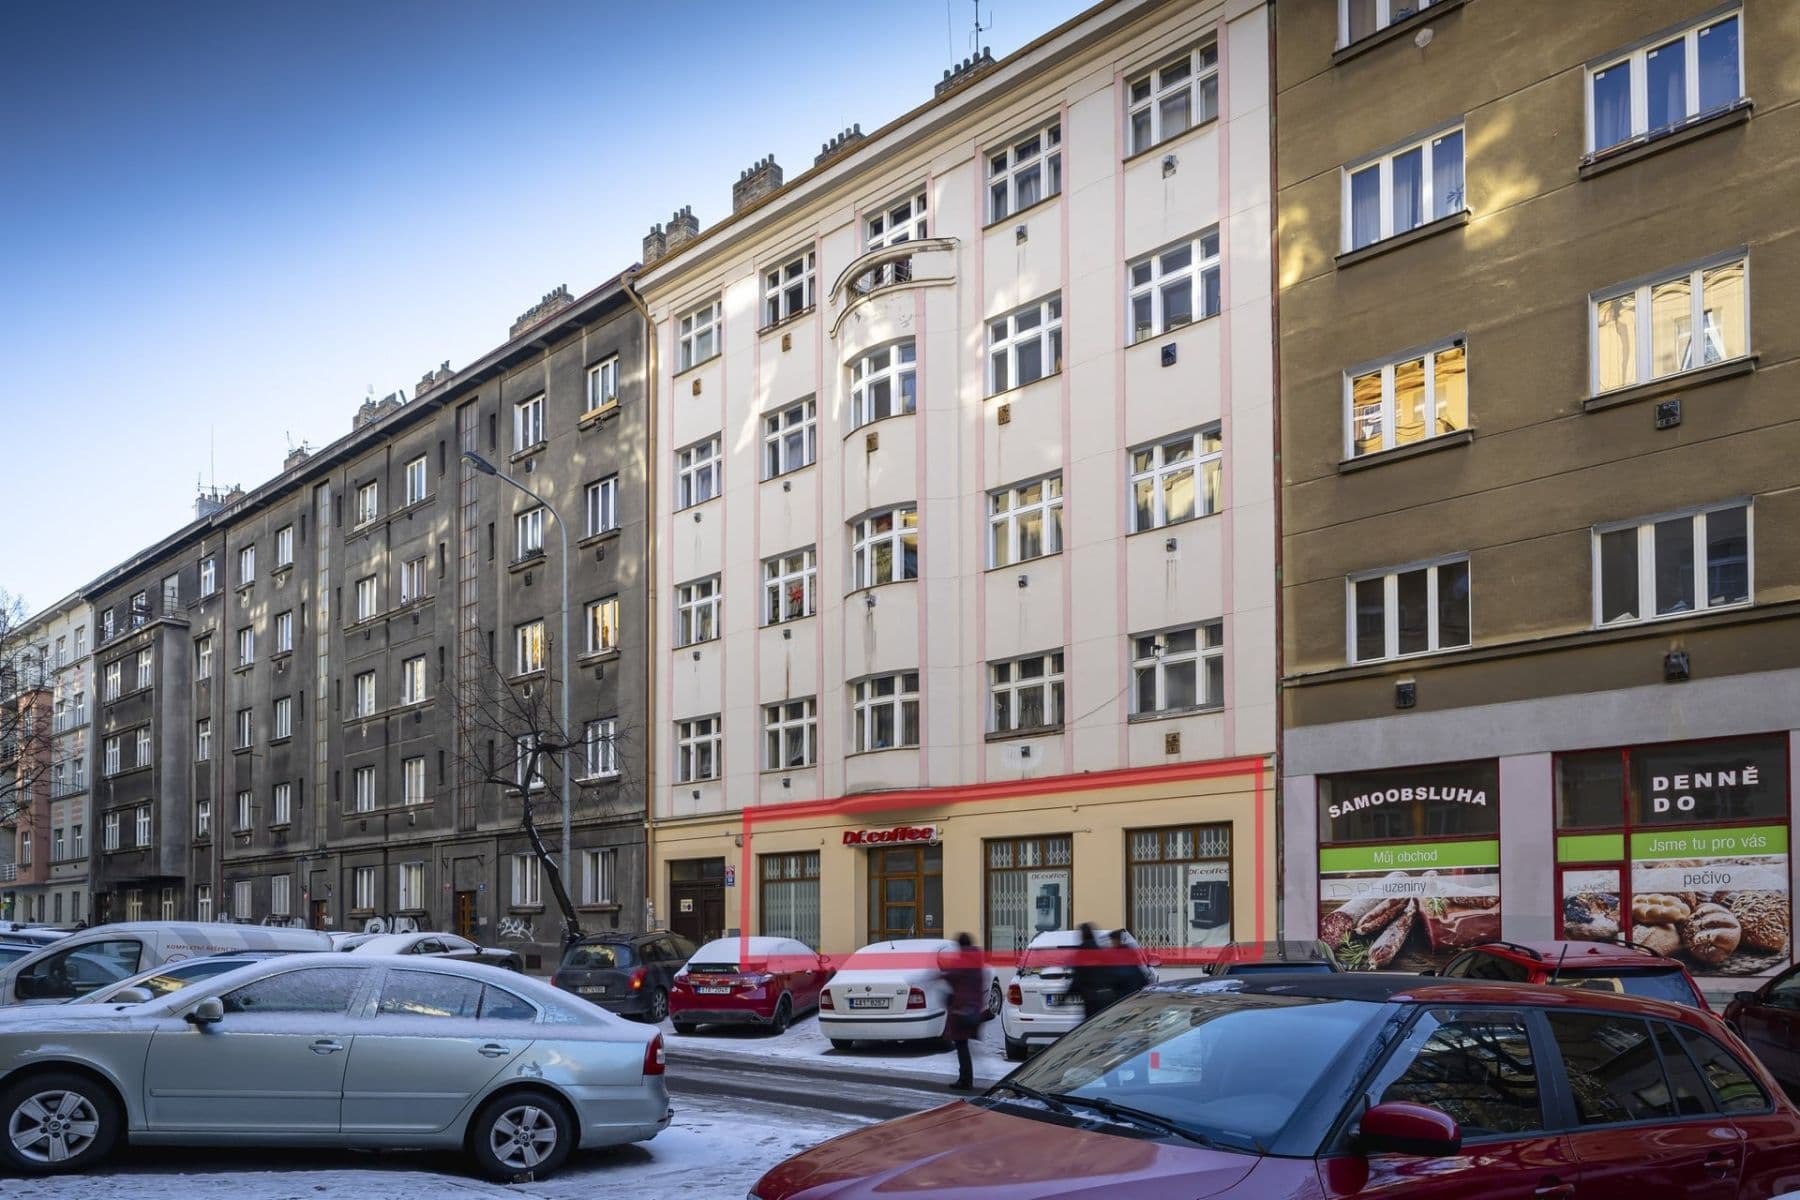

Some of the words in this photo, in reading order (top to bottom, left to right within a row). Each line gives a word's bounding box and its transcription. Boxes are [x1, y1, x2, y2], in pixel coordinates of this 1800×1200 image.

[1652, 766, 1759, 791] DENNĚ
[1328, 787, 1487, 818] SAMOOBSLUHA
[1654, 796, 1695, 812] DO
[1649, 839, 1686, 852] Jsme
[1692, 838, 1706, 850] tu
[1712, 837, 1735, 854] pro
[1741, 835, 1766, 848] vás
[1374, 851, 1393, 864] Můj
[1398, 850, 1437, 862] obchod
[1385, 881, 1426, 893] uzeniny
[1683, 872, 1731, 887] pečivo
